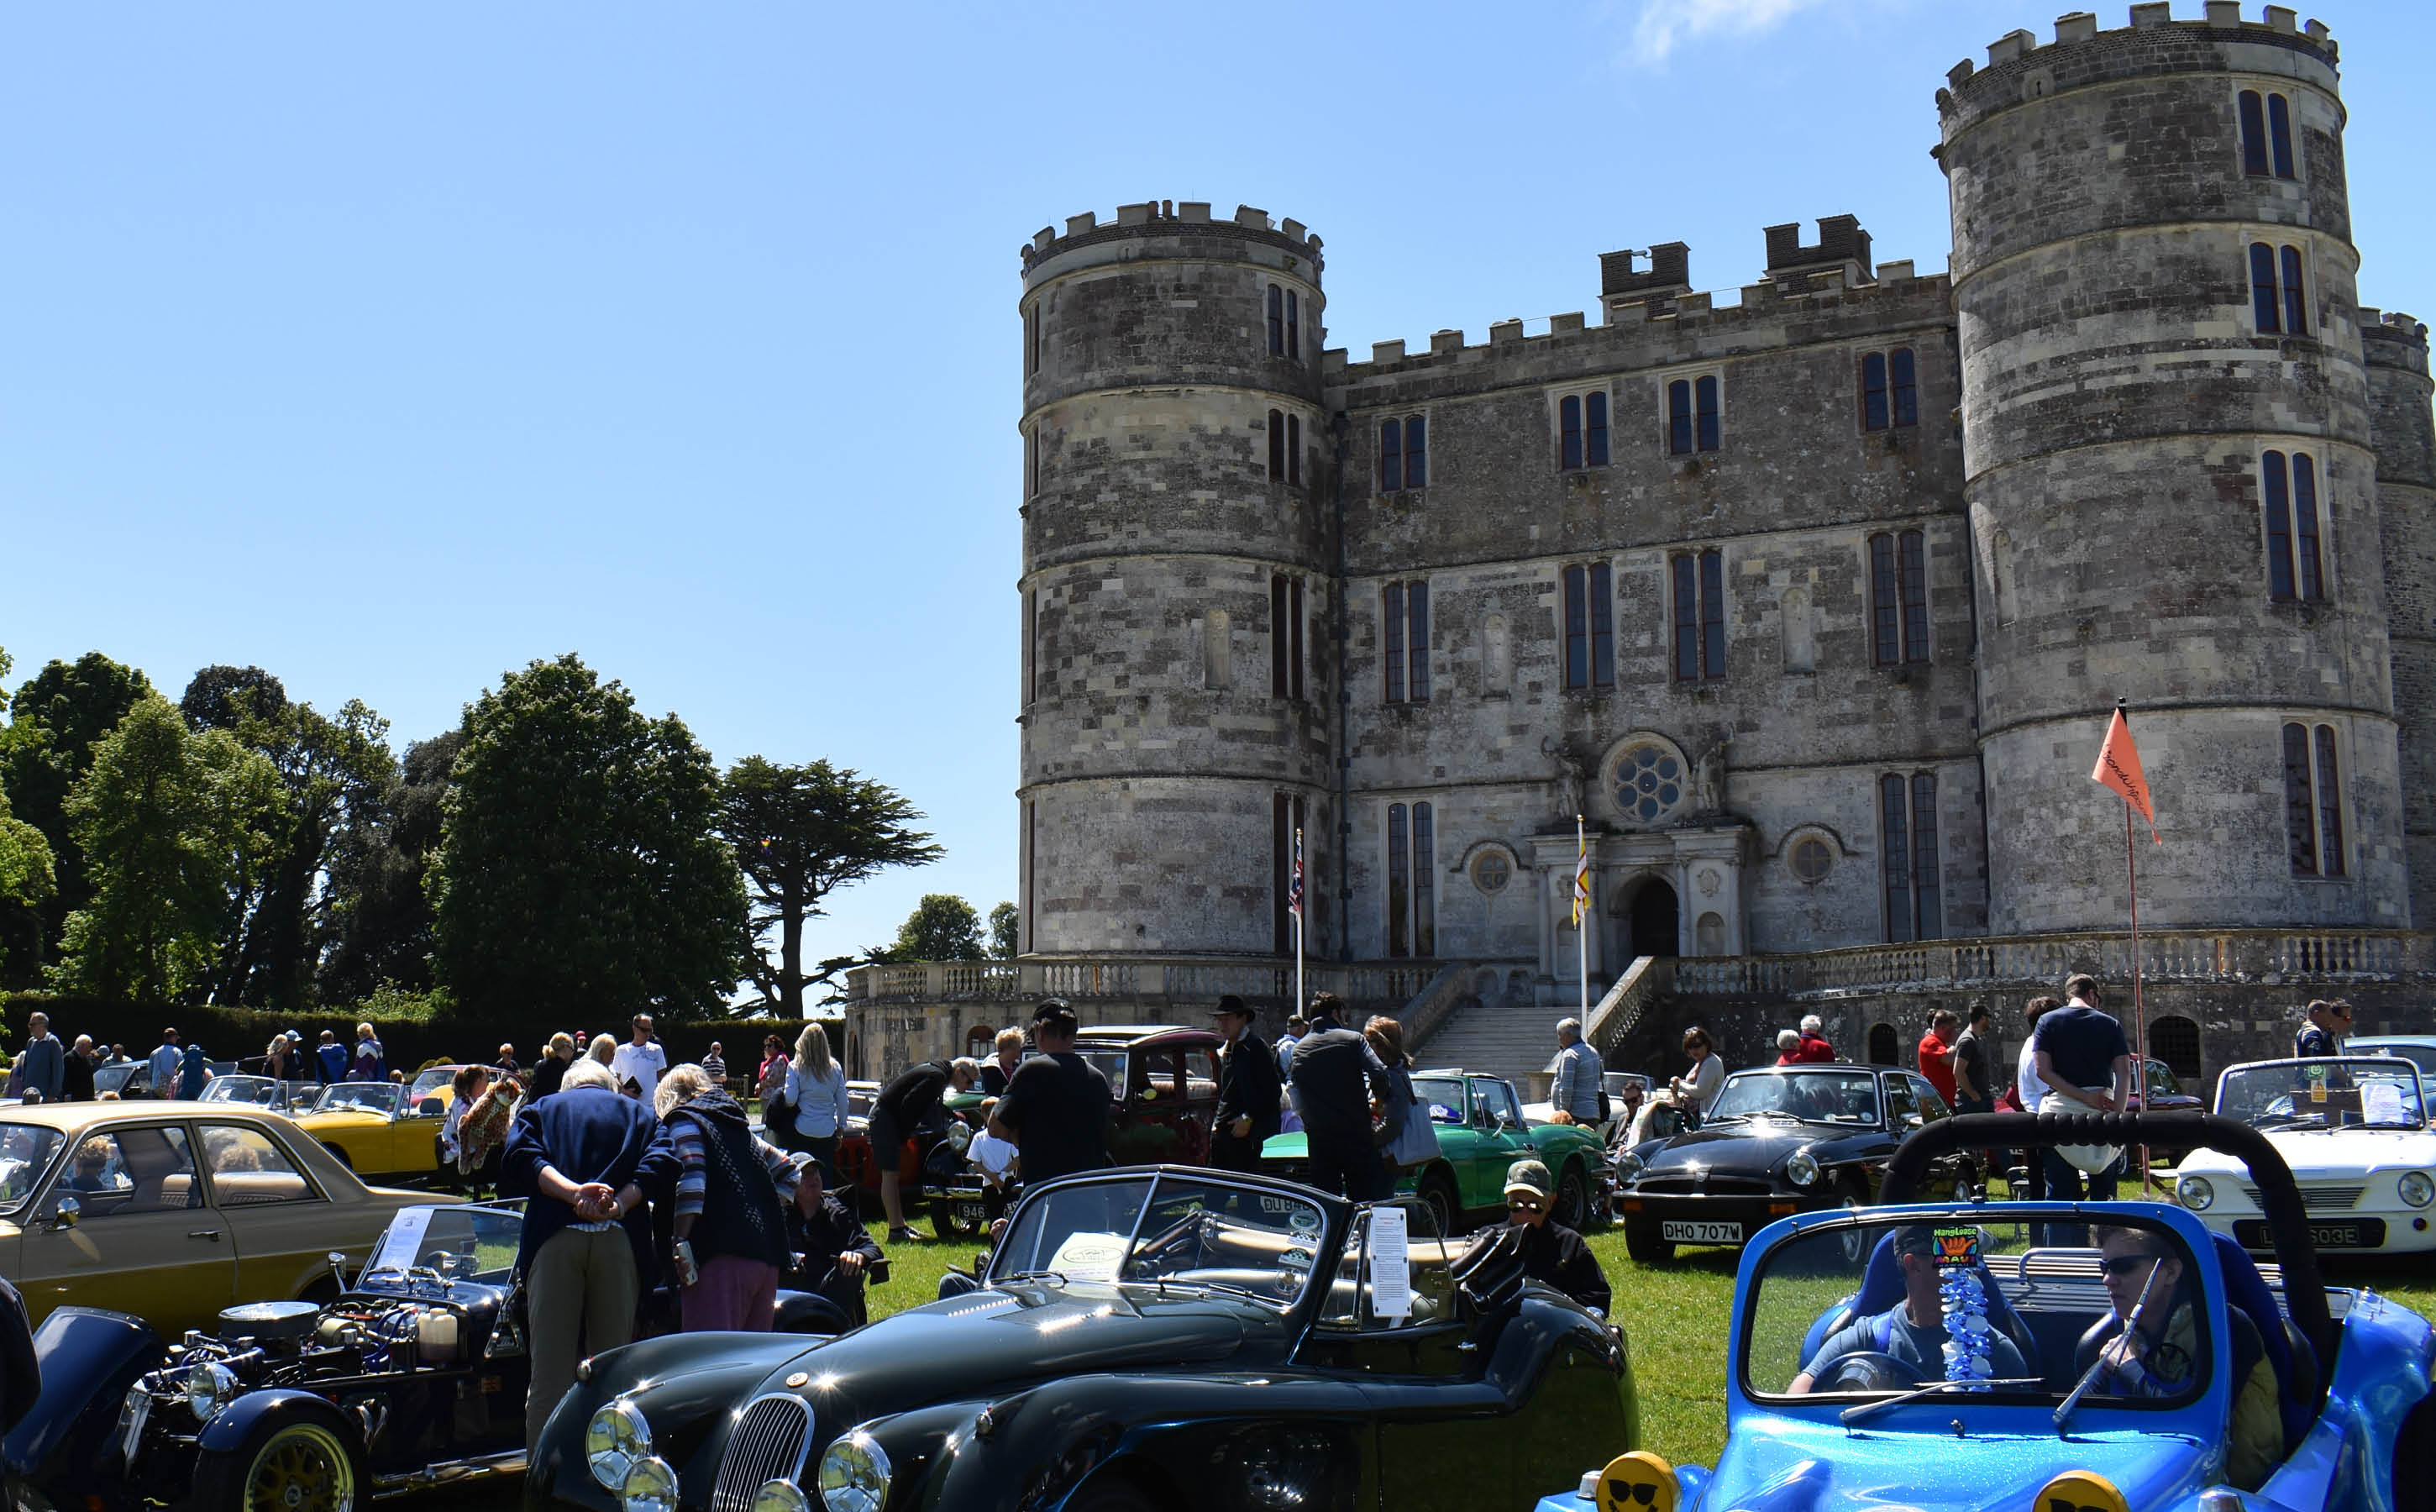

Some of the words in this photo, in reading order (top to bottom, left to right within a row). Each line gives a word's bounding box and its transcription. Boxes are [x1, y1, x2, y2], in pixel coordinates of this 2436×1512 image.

[962, 1205, 985, 1218] 946
[1664, 1224, 1694, 1239] DHO
[1698, 1225, 1740, 1240] 707W
